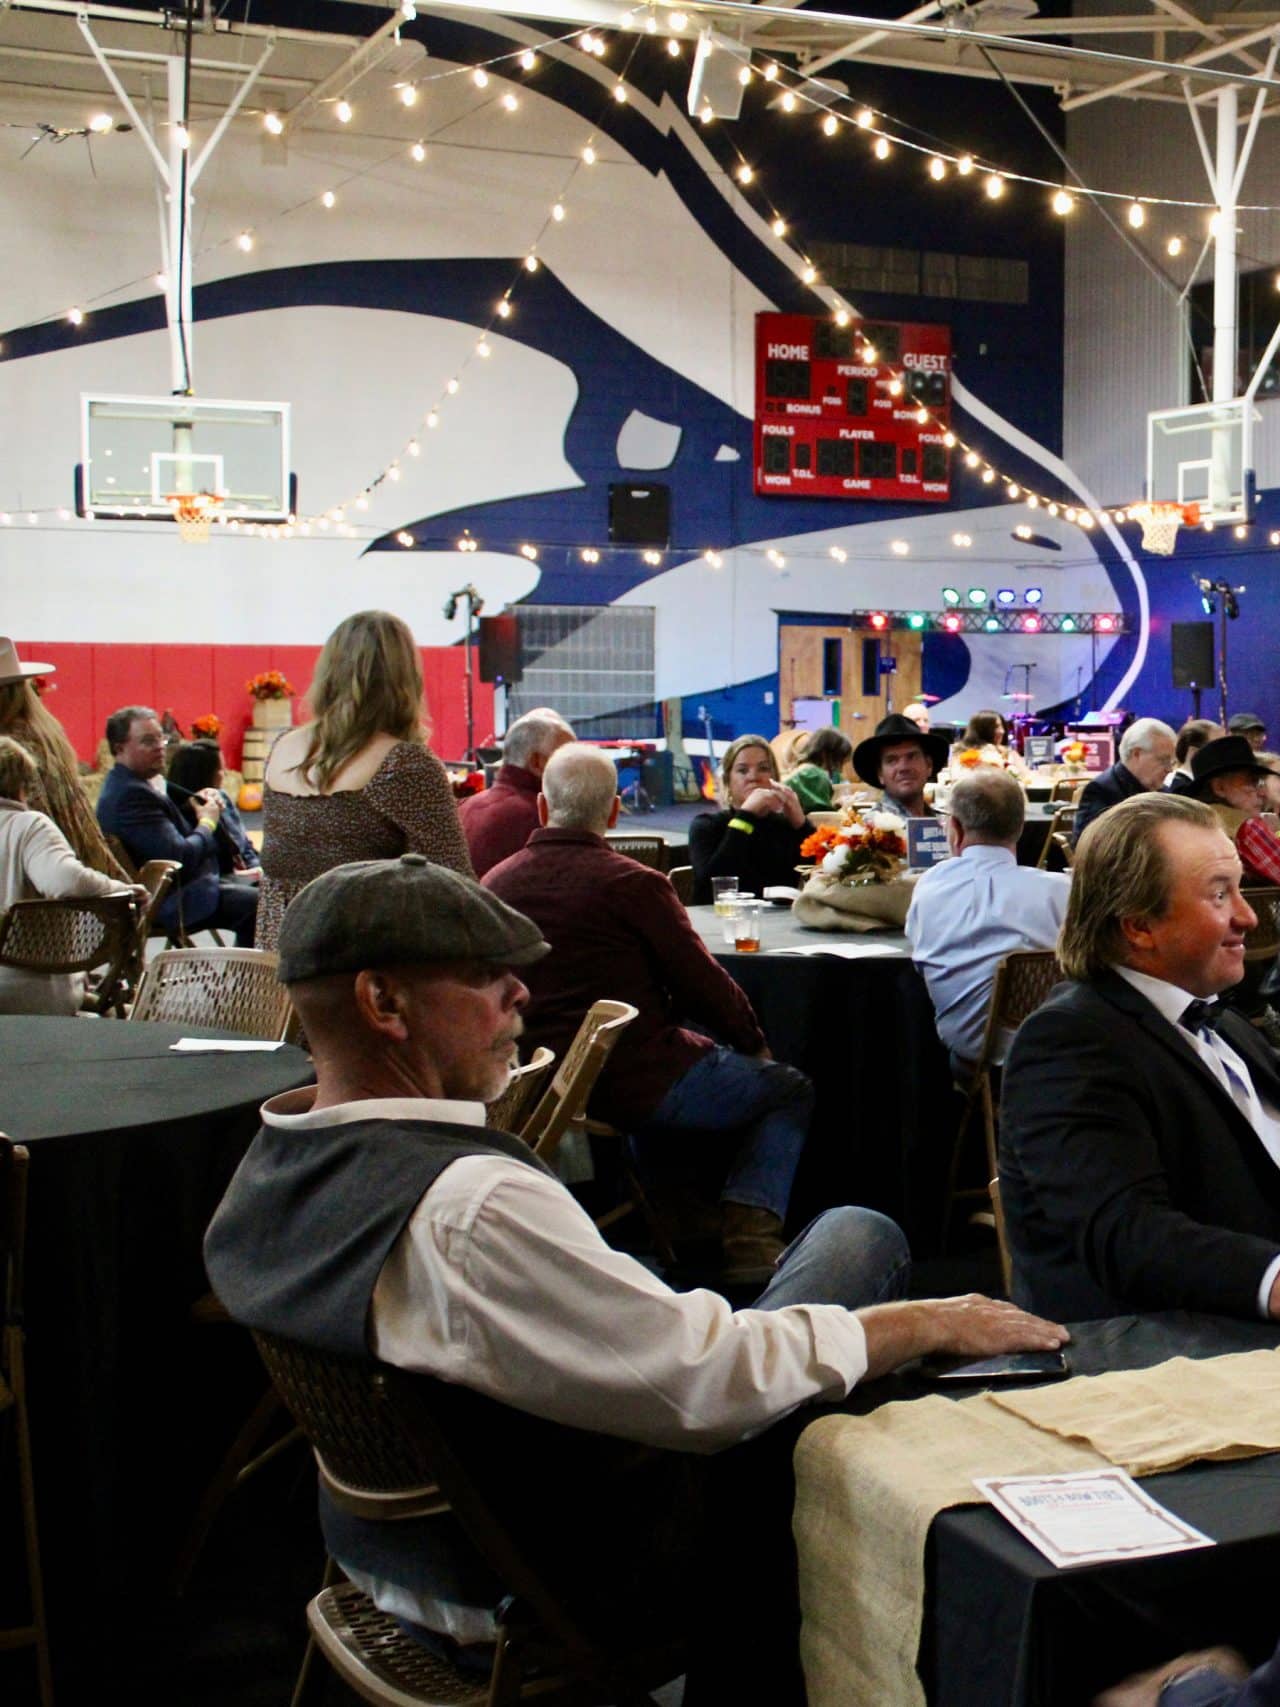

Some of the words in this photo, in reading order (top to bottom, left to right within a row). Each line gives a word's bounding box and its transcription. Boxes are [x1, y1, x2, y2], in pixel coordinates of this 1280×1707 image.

[768, 343, 809, 361] HOME
[903, 353, 947, 370] GUEST
[837, 365, 878, 378] PERIOD
[786, 403, 821, 416] BONUS
[762, 425, 795, 436] FOULS
[839, 428, 875, 440] PLAYER
[764, 475, 792, 487] WON
[843, 478, 872, 490] GAME
[922, 481, 948, 493] WON
